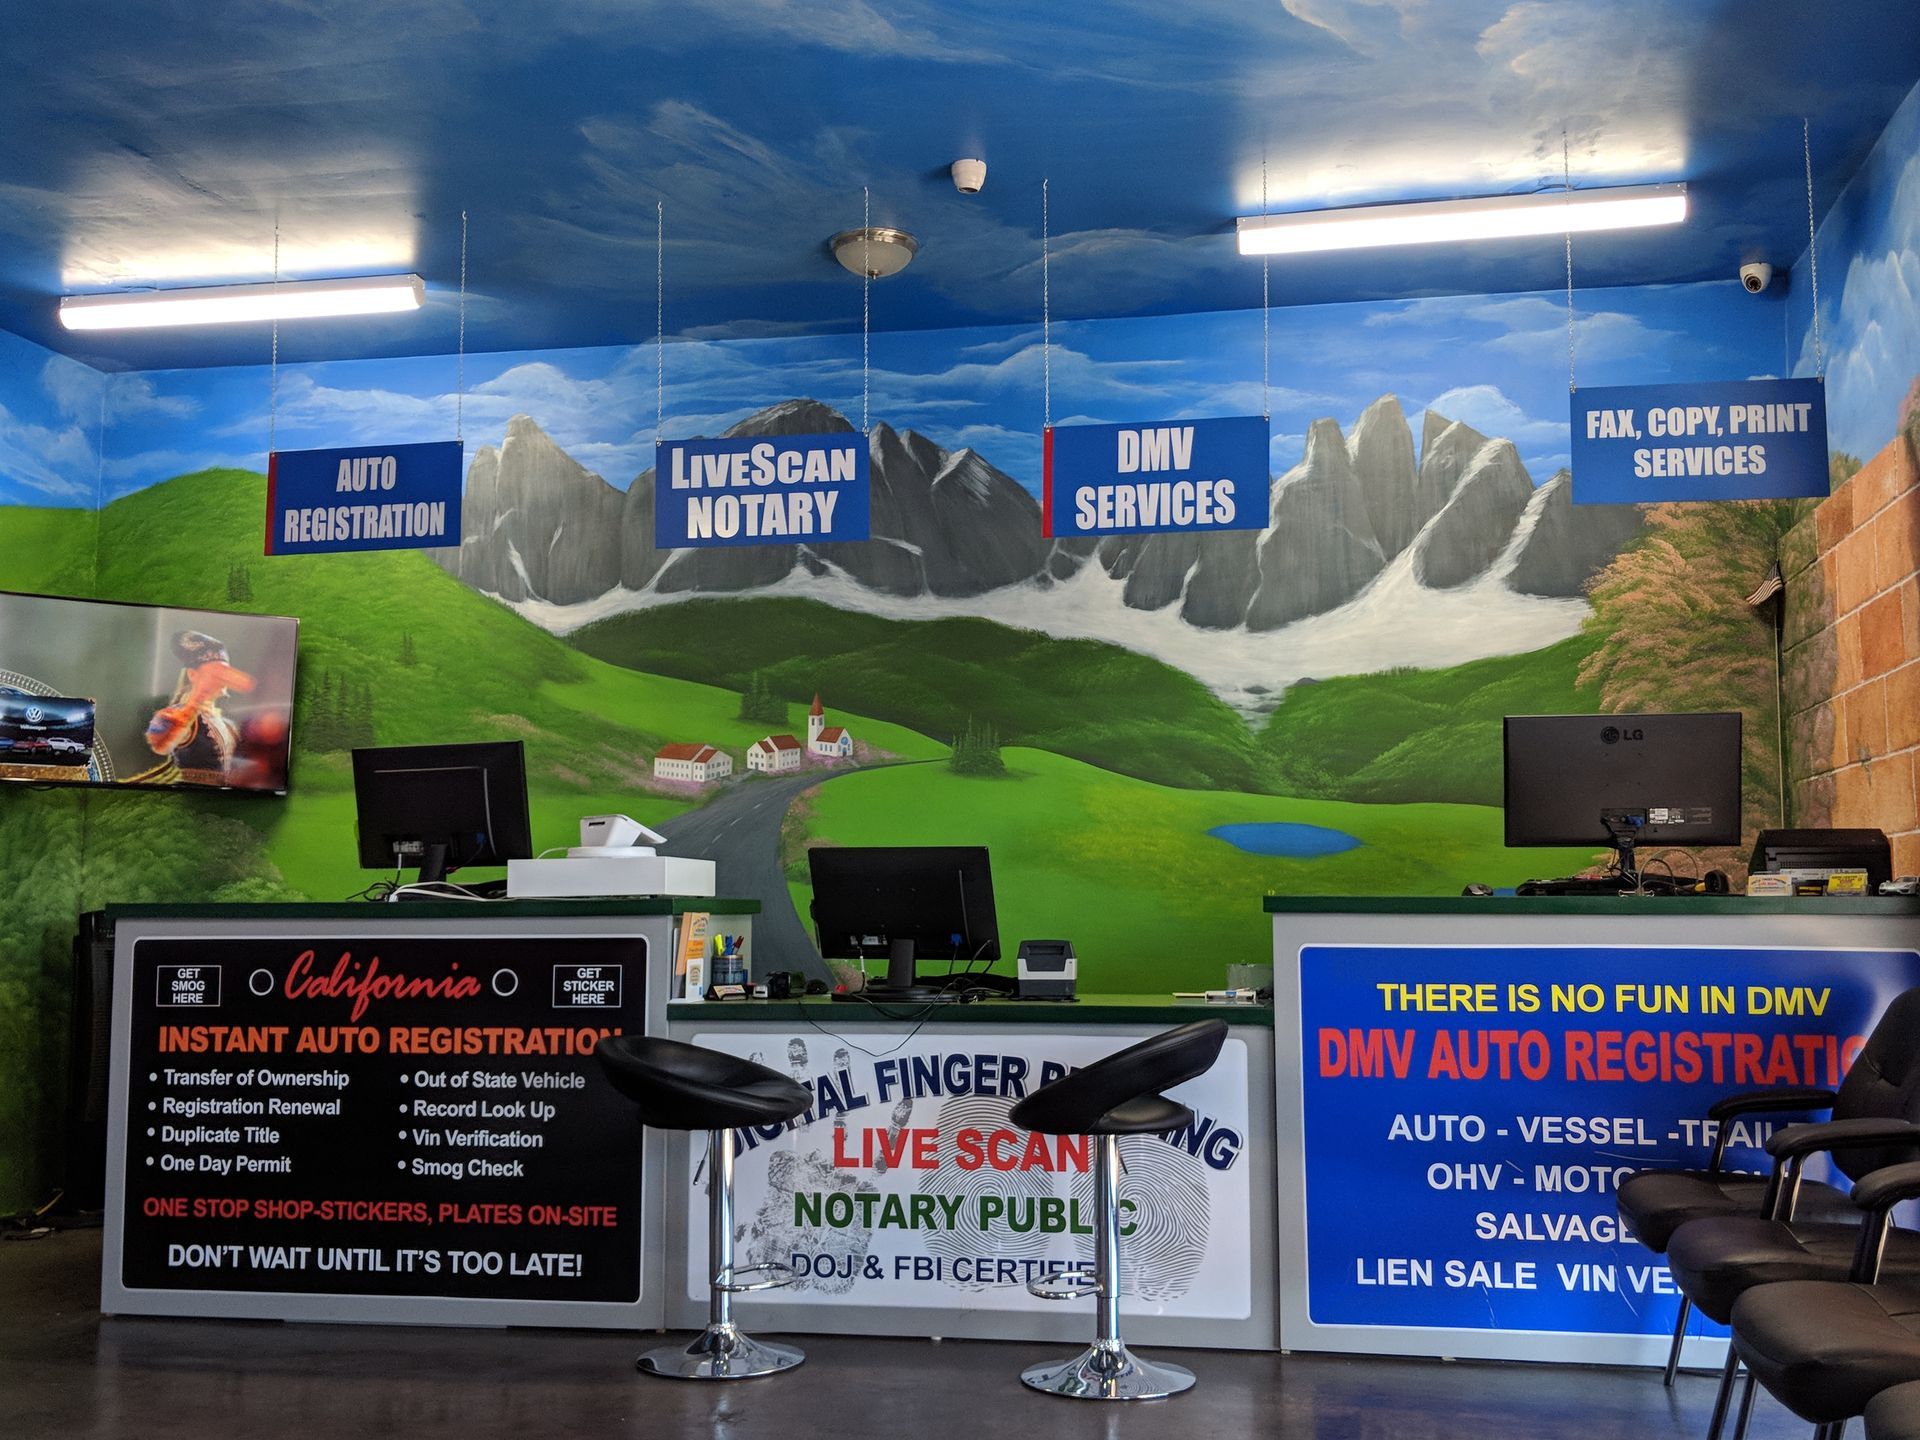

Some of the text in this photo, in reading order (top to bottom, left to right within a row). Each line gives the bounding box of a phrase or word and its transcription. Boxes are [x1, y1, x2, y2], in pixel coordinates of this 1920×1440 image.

[1586, 403, 1812, 441] FAX, COPY, PRINT
[1117, 426, 1194, 473] DMV
[1633, 445, 1767, 478] SERVICES
[336, 456, 397, 492] AUTO
[687, 490, 839, 539] NOTARY
[1075, 479, 1236, 530] SERVICES
[284, 501, 446, 543] REGISTRATION
[1623, 729, 1643, 740] LG
[171, 980, 205, 992] SMOG
[177, 968, 200, 979] GET
[284, 950, 481, 1022] California
[563, 980, 614, 992] STICKER
[577, 967, 601, 979] GET
[172, 993, 203, 1004] HERE
[572, 994, 605, 1005] HERE
[1376, 983, 1831, 1016] THERE IS NO FUN IN DMV
[159, 1026, 622, 1056] INSTANT AUTO REGISTRATIO
[1318, 1028, 1416, 1079] DMV
[1427, 1029, 1550, 1080] AUTO
[164, 1069, 350, 1090] Transfer of Ownership
[414, 1070, 586, 1090] Out of State Vehicle
[874, 1053, 1029, 1104] FINGER
[163, 1097, 341, 1117] Registration Renewal
[413, 1100, 556, 1122] Record Look Up
[161, 1126, 280, 1146] Duplicate Title
[412, 1129, 544, 1148] Vin Verification
[1387, 1114, 1486, 1142] AUTO
[1516, 1116, 1657, 1146] VESSEL
[160, 1154, 292, 1176] One Day Permit
[832, 1127, 1089, 1173] LIVE SCAN
[411, 1158, 524, 1180] Smog Check
[1427, 1163, 1503, 1191] OHV
[143, 1197, 618, 1227] ONE STOP SHOP-STICKERS, PLATES ON-SITE
[794, 1191, 1138, 1237] NOTARY PUBLC
[249, 1246, 311, 1270] WAIT
[317, 1248, 390, 1272] UNTIL
[447, 1251, 503, 1275] TOO
[509, 1253, 583, 1277] LATE!
[791, 1253, 1095, 1286] DOJ & FBI CERTIFIE
[1356, 1258, 1433, 1287] LIEN
[1444, 1260, 1537, 1290] SALE
[1556, 1263, 1616, 1292] VIN
